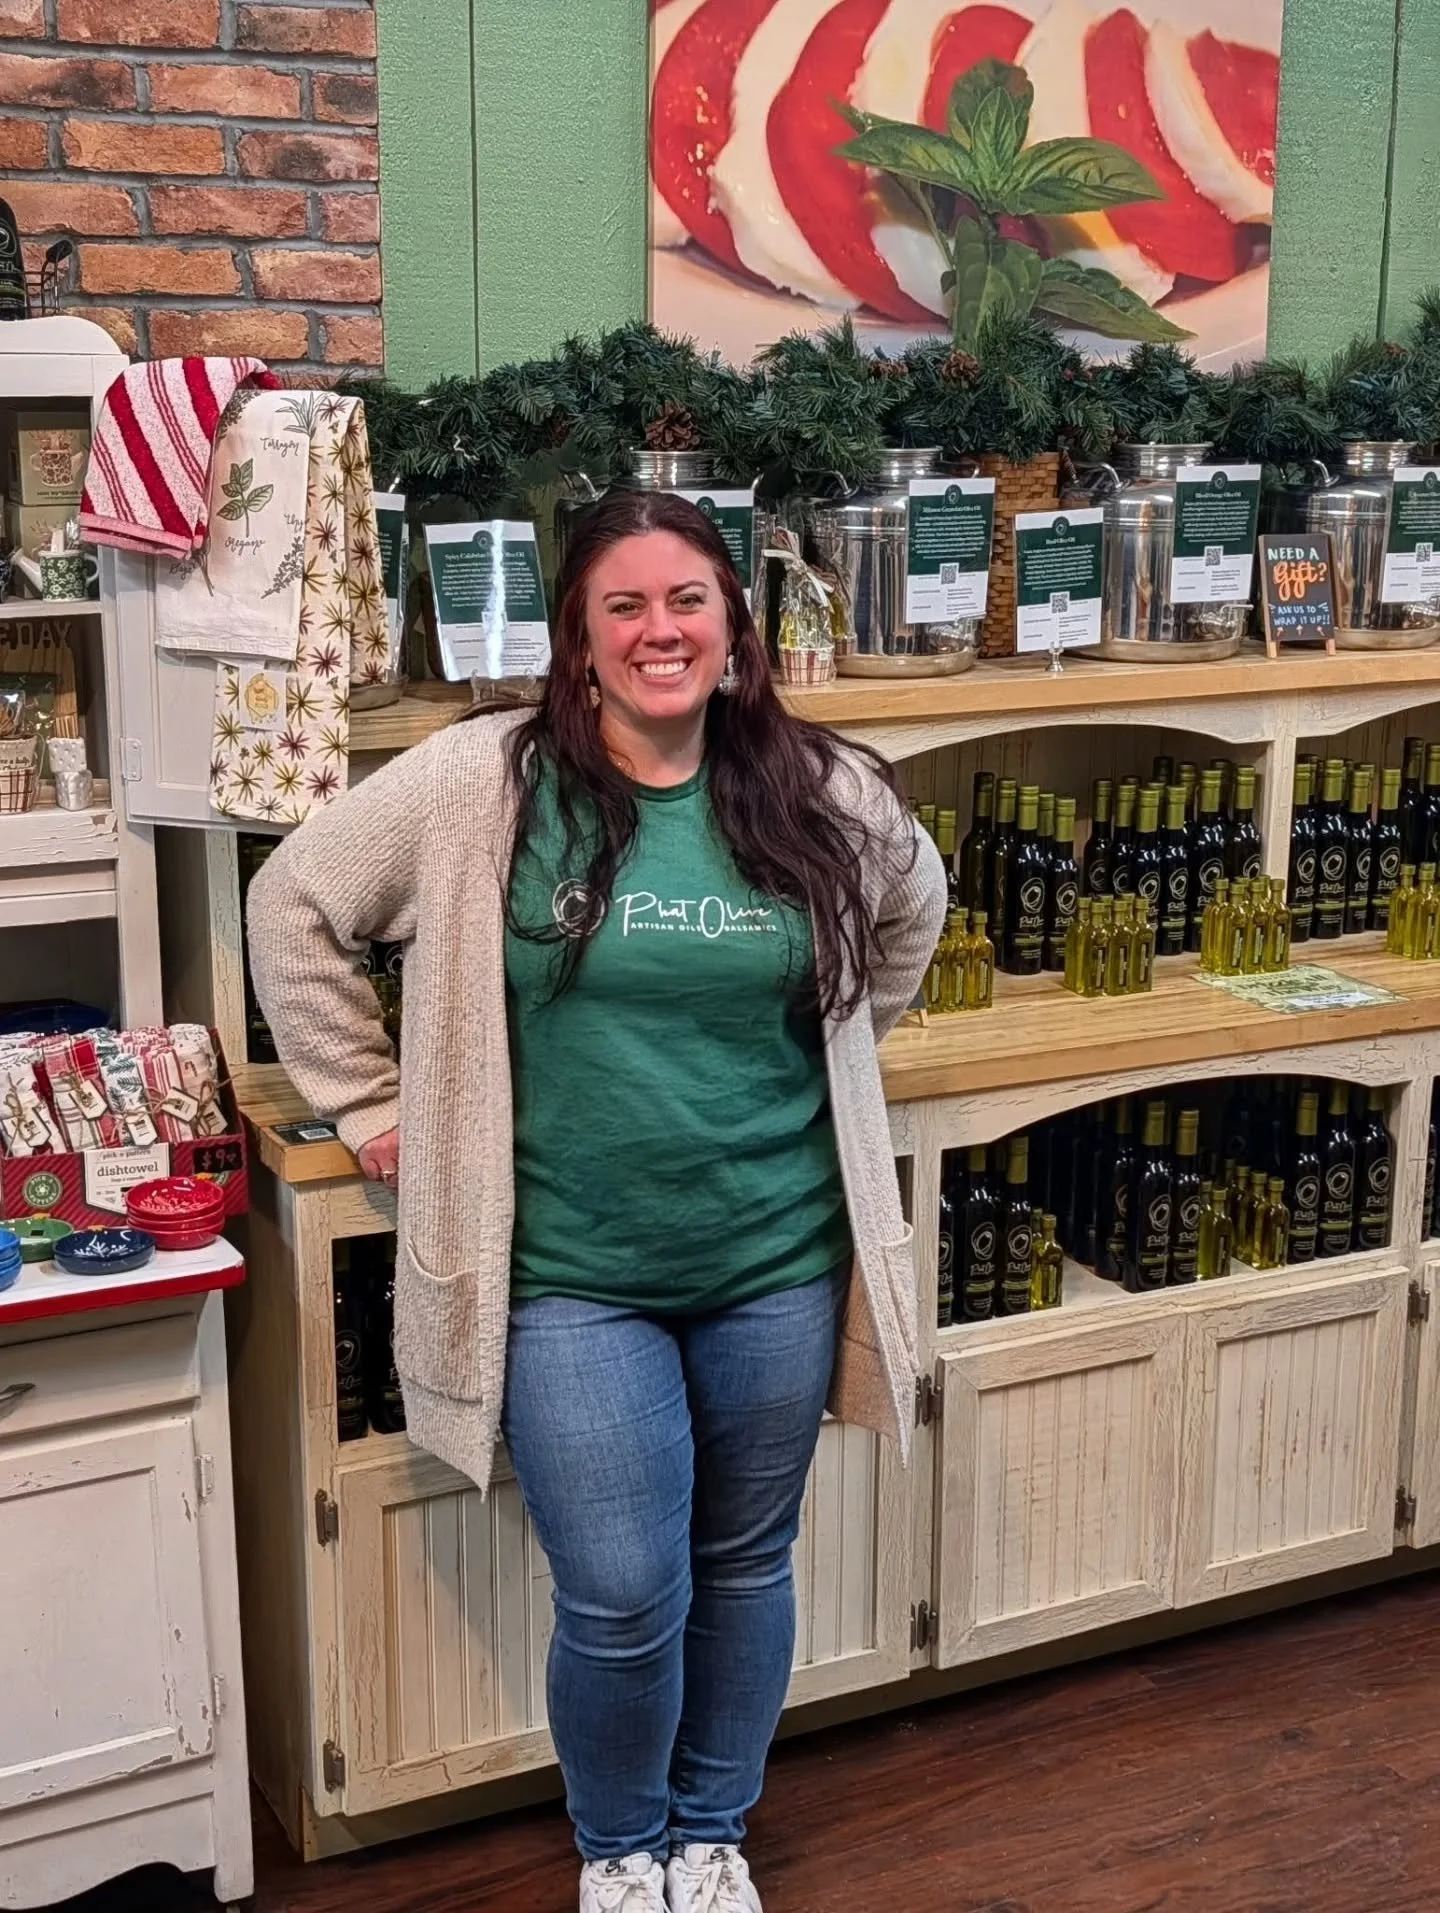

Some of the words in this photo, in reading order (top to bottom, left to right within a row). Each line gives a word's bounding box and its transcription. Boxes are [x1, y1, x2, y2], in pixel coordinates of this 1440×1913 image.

[260, 437, 299, 457] Tarragon
[1267, 547, 1304, 560] NEED
[1309, 547, 1320, 561] A
[1278, 605, 1292, 615] ASK
[1293, 604, 1305, 614] US
[1306, 604, 1317, 614] TO
[1273, 616, 1297, 626] WRAP
[1299, 616, 1308, 625] IT
[615, 891, 697, 937] Phat
[698, 895, 773, 939] Olive
[630, 922, 675, 931] ARTISAN
[678, 924, 703, 932] OILS
[97, 1161, 160, 1177] dishtowel
